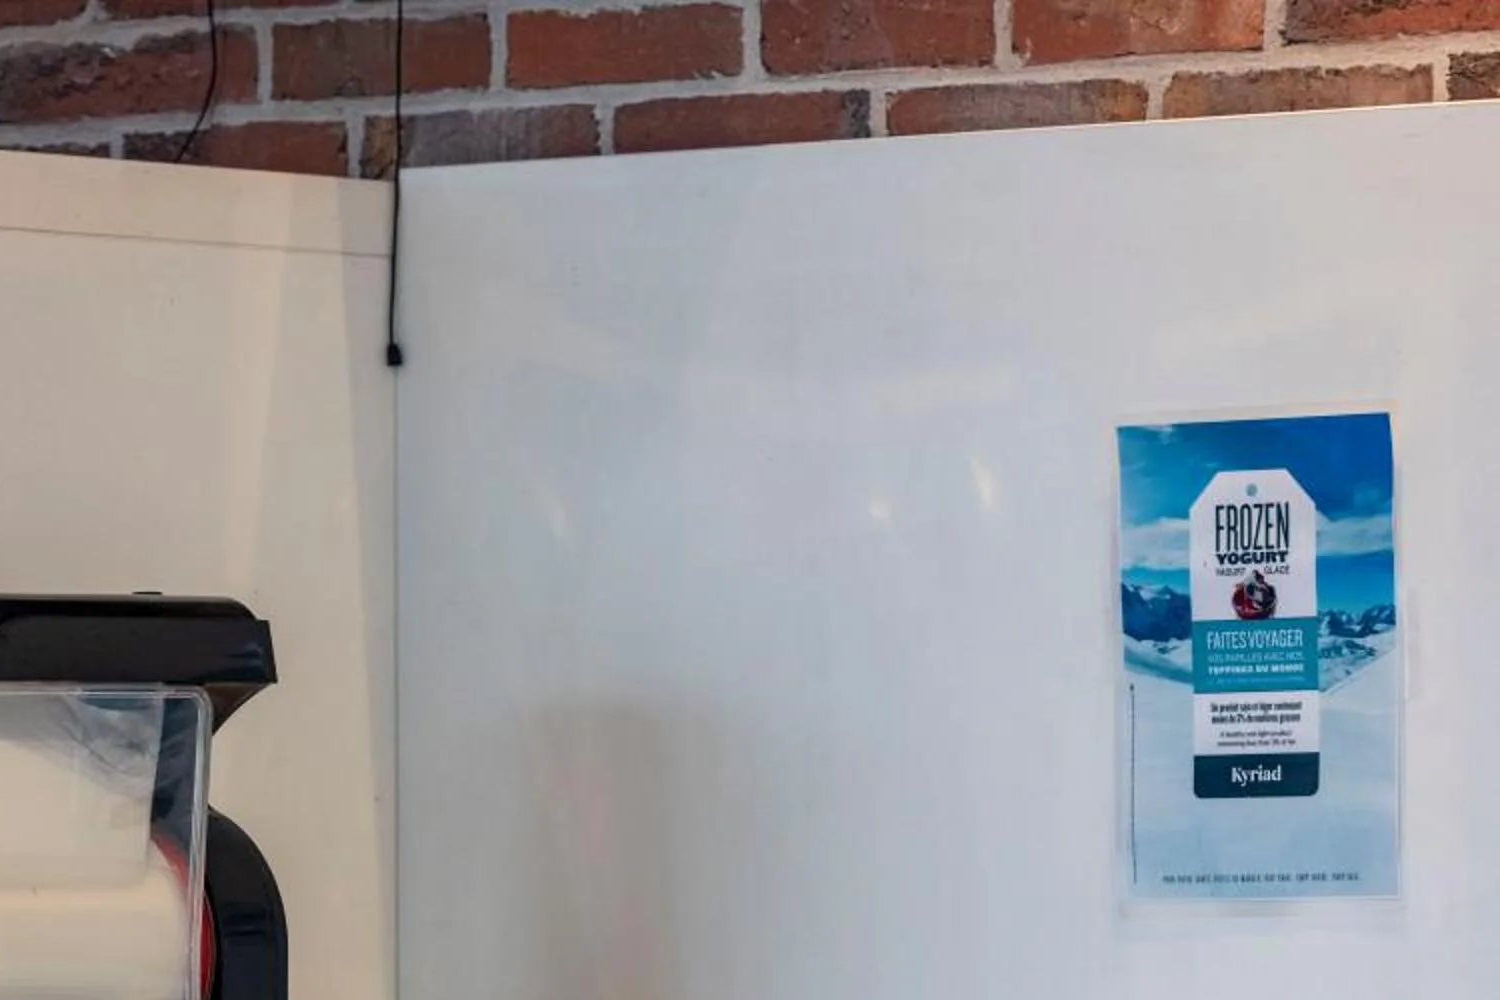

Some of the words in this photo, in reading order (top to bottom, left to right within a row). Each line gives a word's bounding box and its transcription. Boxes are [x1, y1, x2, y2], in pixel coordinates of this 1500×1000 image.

[1215, 502, 1289, 552] FROZEN
[1216, 550, 1288, 565] YOGURT
[1231, 764, 1281, 787] Kyriad
